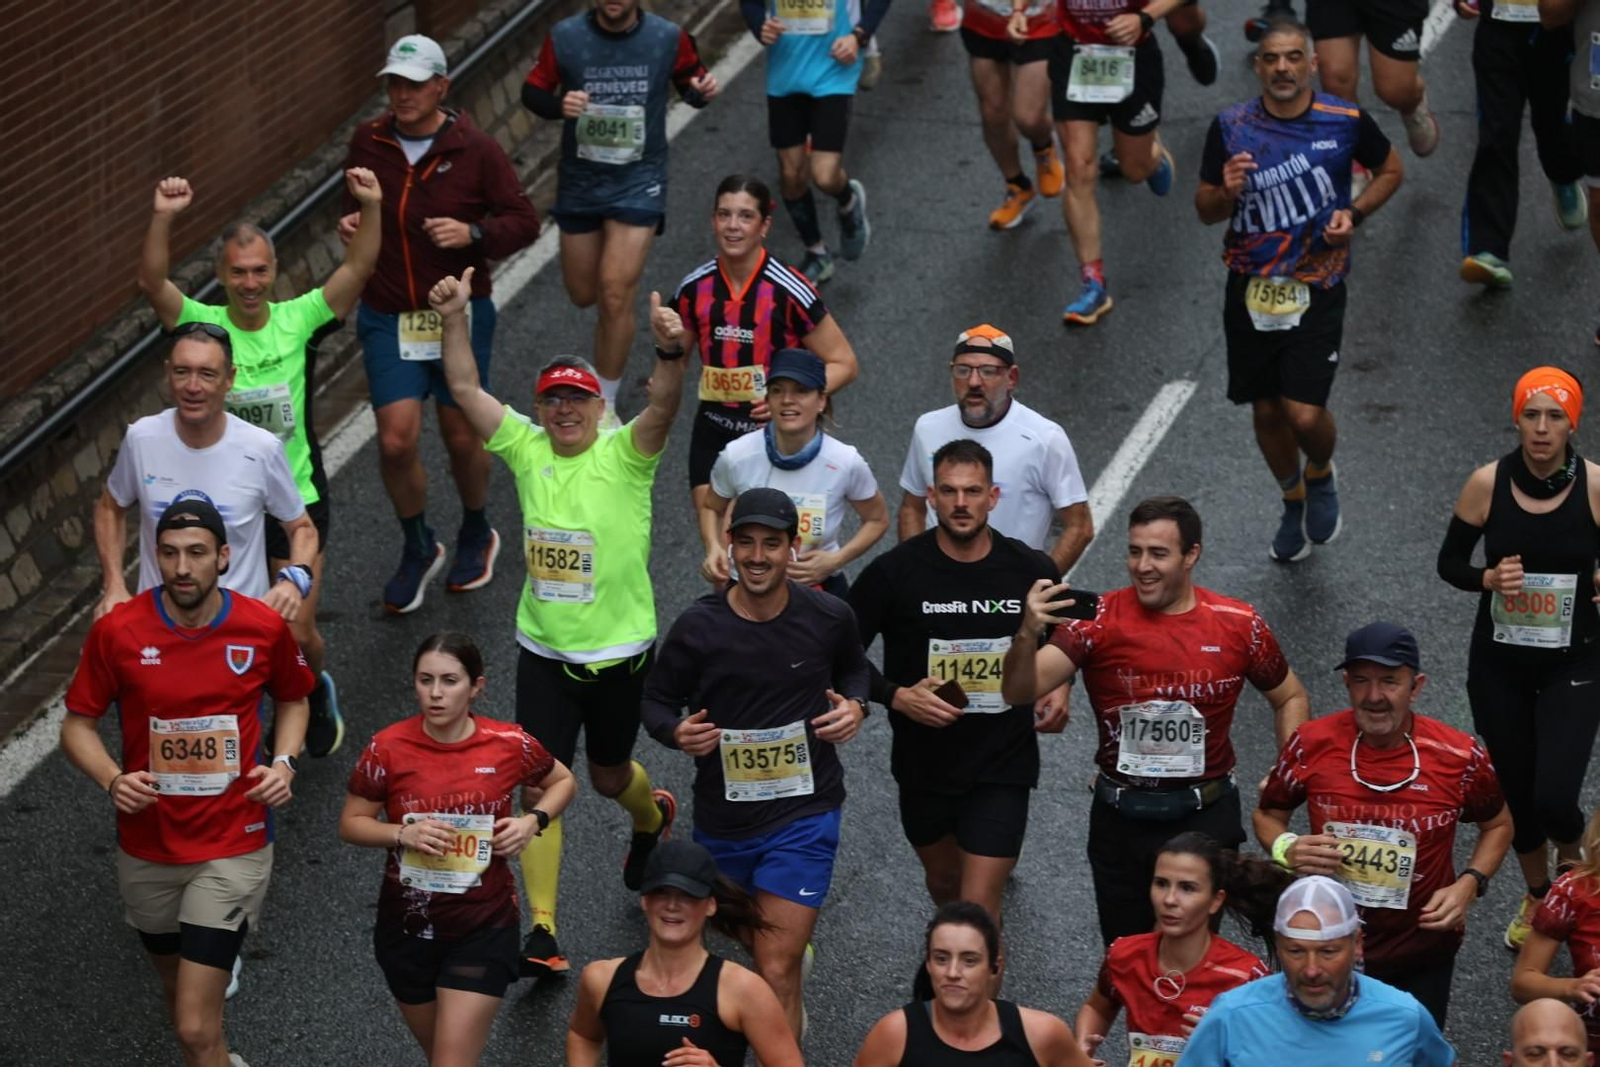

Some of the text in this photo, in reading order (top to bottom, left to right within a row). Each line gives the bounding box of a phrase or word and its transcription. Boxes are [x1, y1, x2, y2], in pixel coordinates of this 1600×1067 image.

[1081, 59, 1119, 77] 8416
[586, 119, 627, 138] 8041
[1312, 139, 1338, 150] HOKA
[1253, 152, 1311, 191] MARATÓN
[1233, 165, 1337, 232] SEVILLA
[1253, 281, 1298, 306] 15154
[406, 312, 443, 332] 129
[714, 324, 754, 339] adidas
[704, 371, 753, 392] 13652
[530, 545, 581, 571] 11582
[922, 599, 1022, 614] CrossFit NXS
[1503, 592, 1557, 615] 8308
[936, 658, 1003, 681] 11424
[1129, 717, 1191, 742] 17560
[161, 737, 217, 761] 6348
[729, 742, 796, 770] 13575
[1329, 843, 1399, 874] 2443
